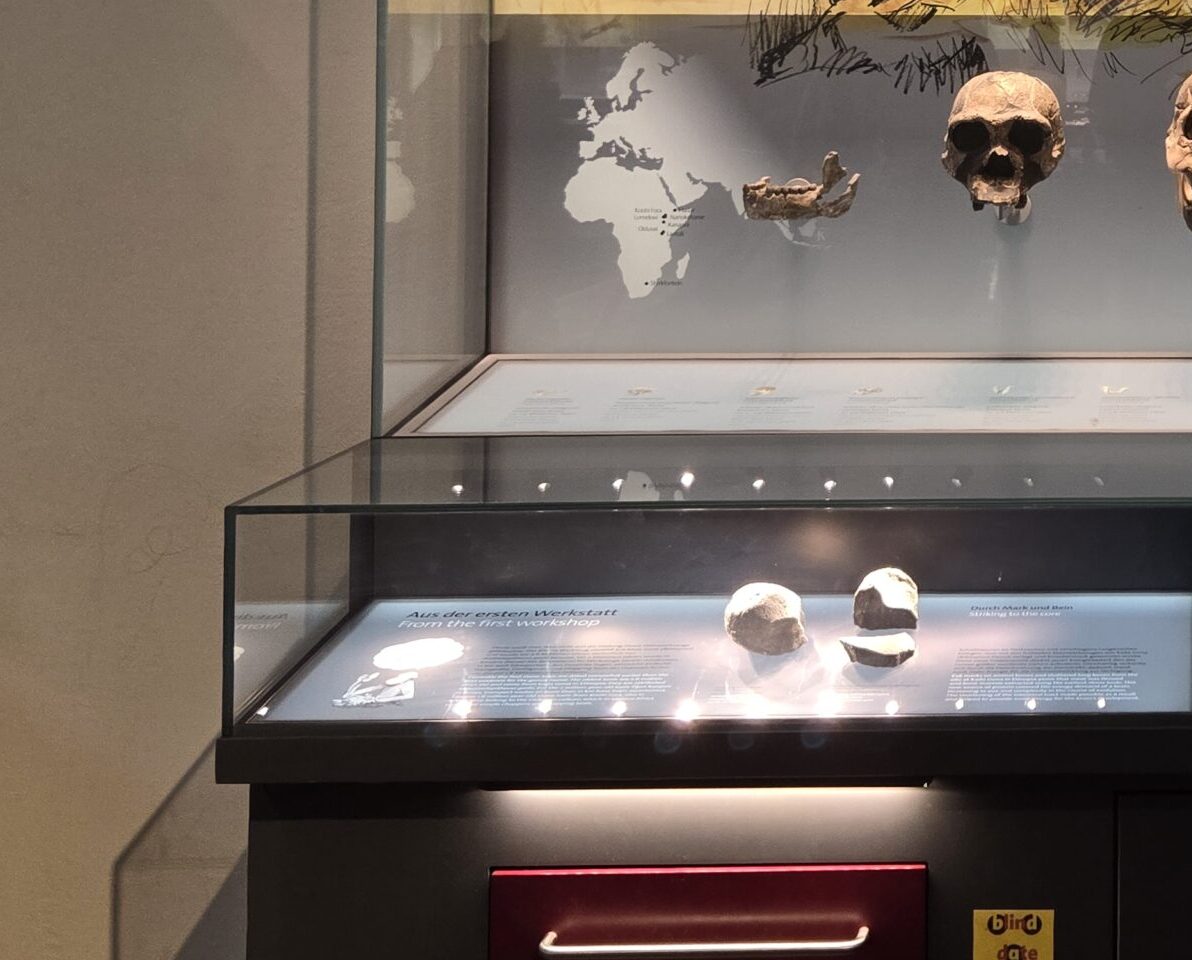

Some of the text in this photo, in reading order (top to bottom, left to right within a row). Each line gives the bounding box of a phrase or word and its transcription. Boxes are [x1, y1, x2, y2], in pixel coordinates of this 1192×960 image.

[406, 608, 618, 619] Aus der ersten Werkstatt
[397, 618, 601, 628] From the first workshop
